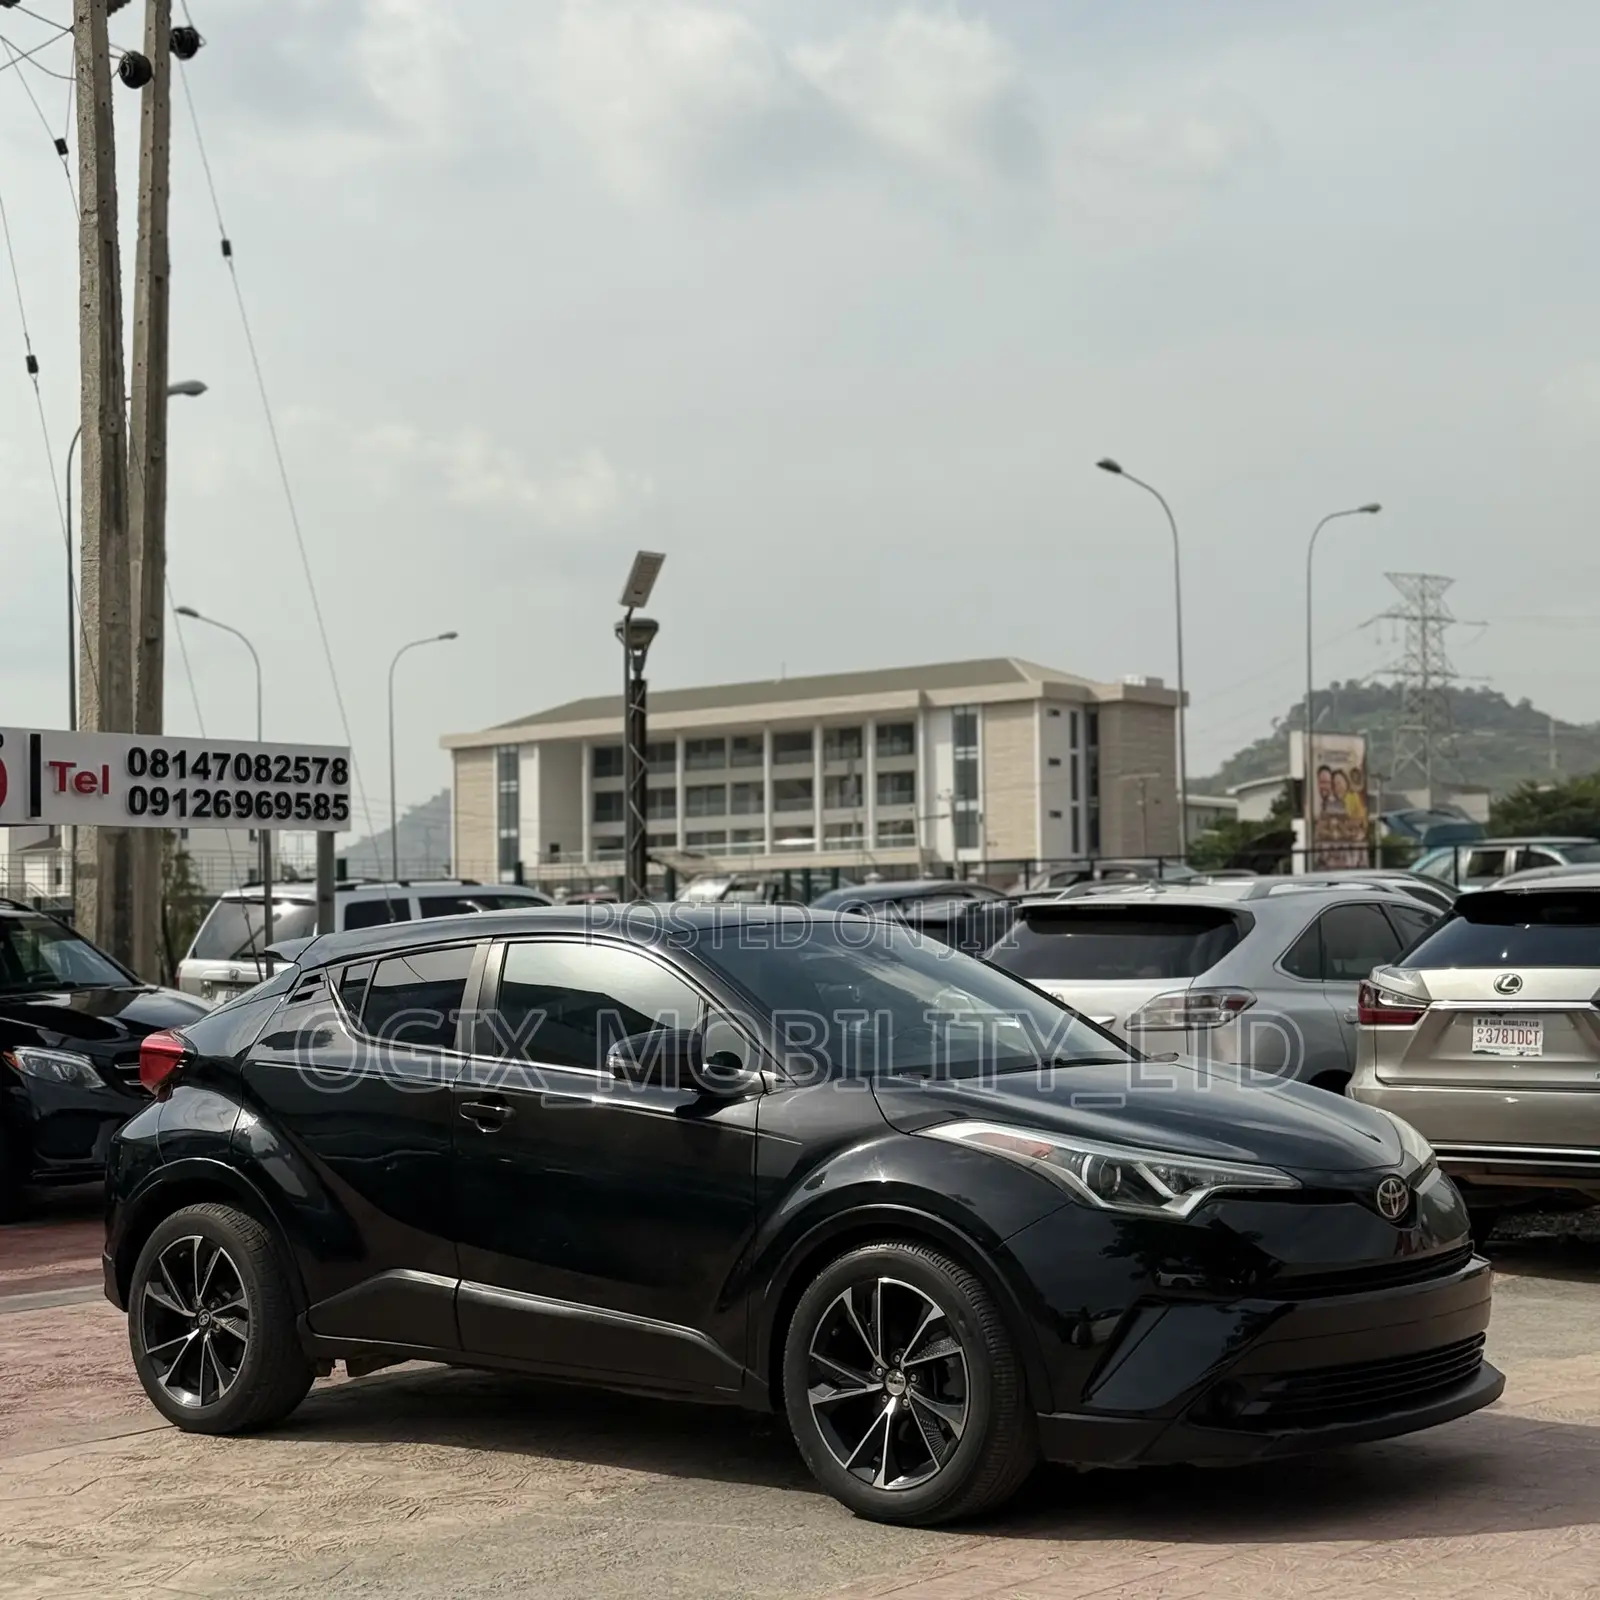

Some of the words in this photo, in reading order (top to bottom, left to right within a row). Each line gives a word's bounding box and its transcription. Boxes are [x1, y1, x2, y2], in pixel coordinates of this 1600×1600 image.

[49, 761, 110, 795] Tel
[127, 746, 349, 786] 08147082578
[127, 785, 349, 822] 09126969585
